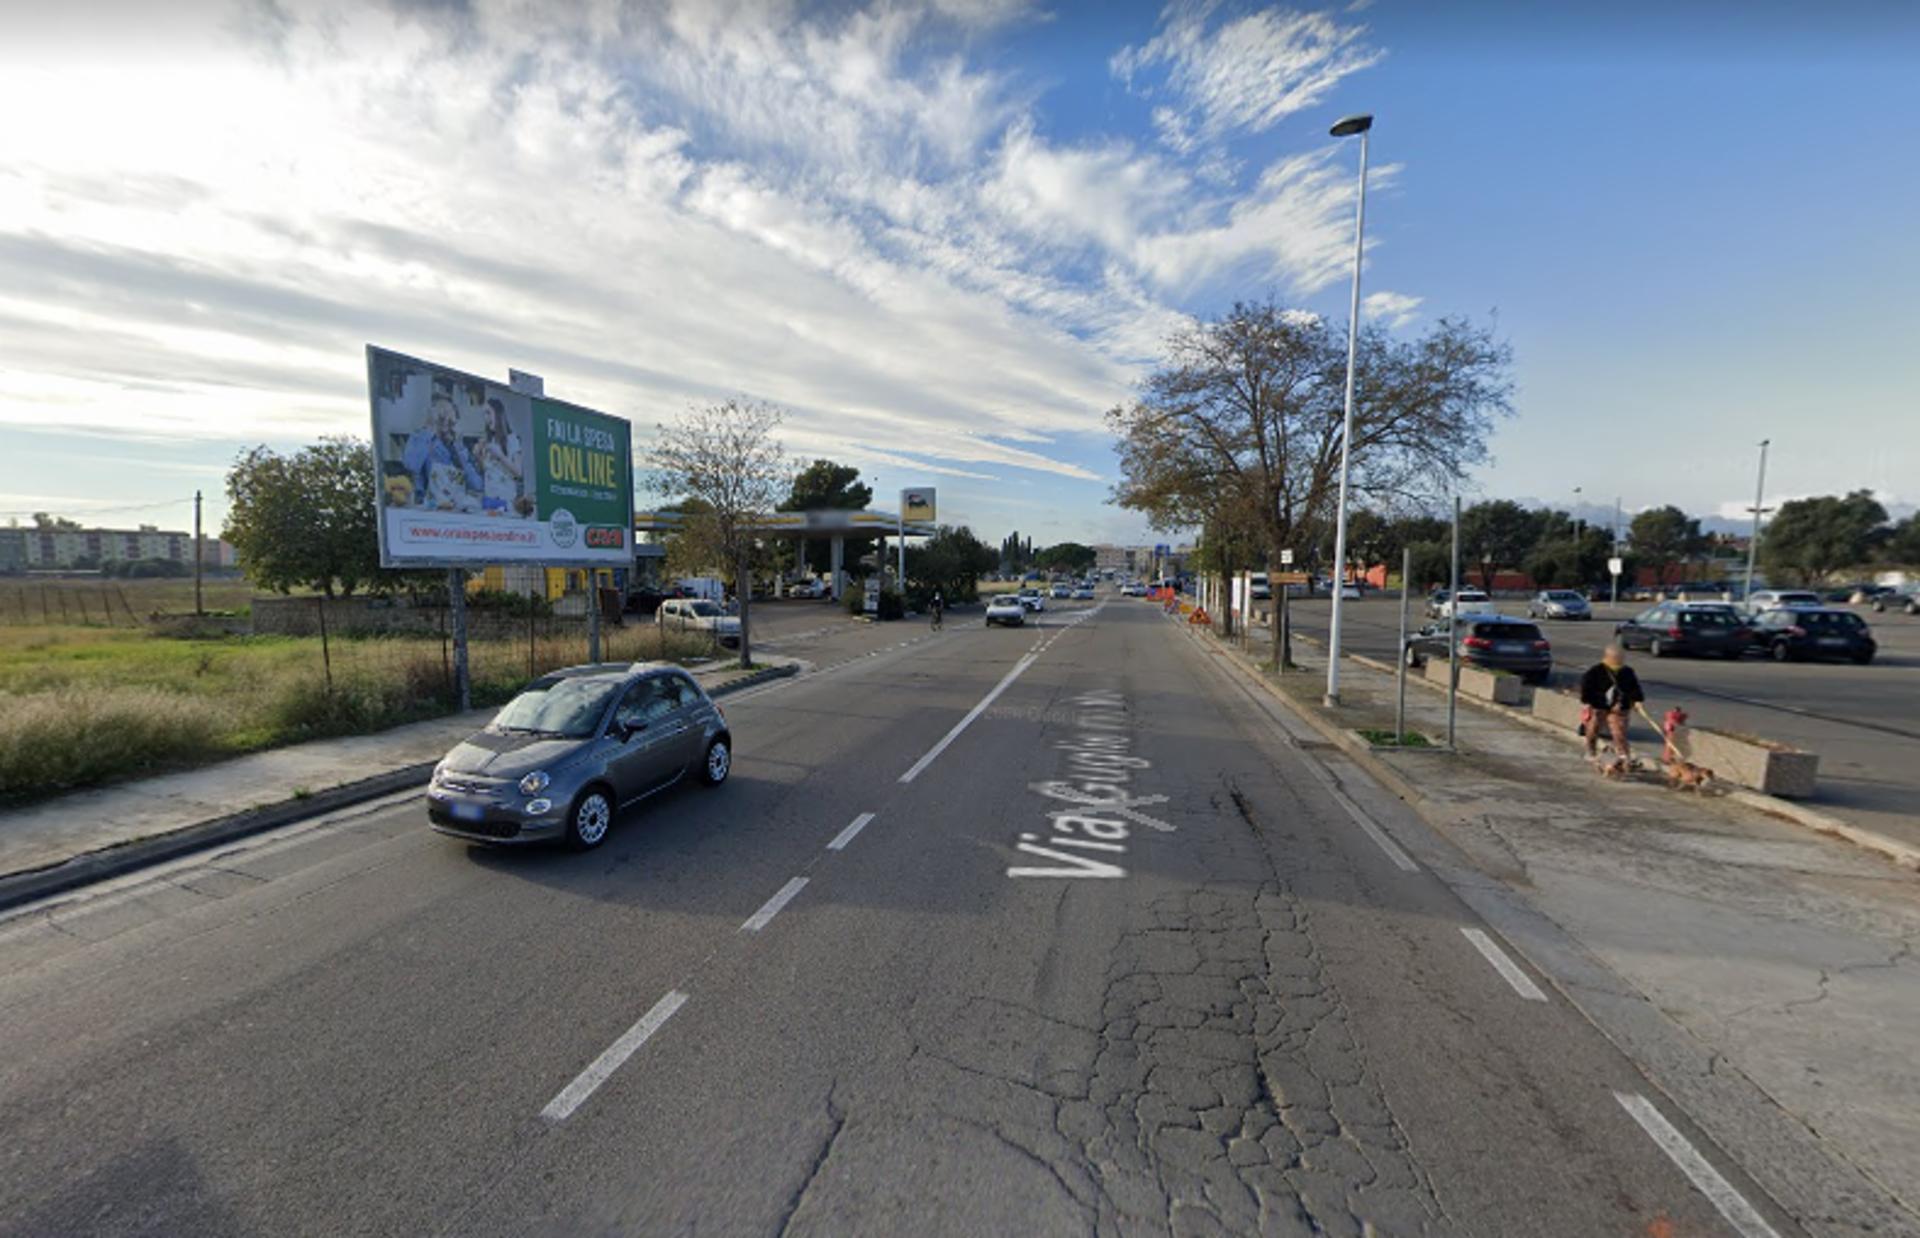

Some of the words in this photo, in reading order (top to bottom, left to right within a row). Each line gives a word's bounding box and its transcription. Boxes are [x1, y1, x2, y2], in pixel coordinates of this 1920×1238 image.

[547, 419, 565, 442] FAI
[567, 421, 581, 444] LA
[583, 425, 615, 452] SPESA
[549, 442, 617, 489] ONLINE
